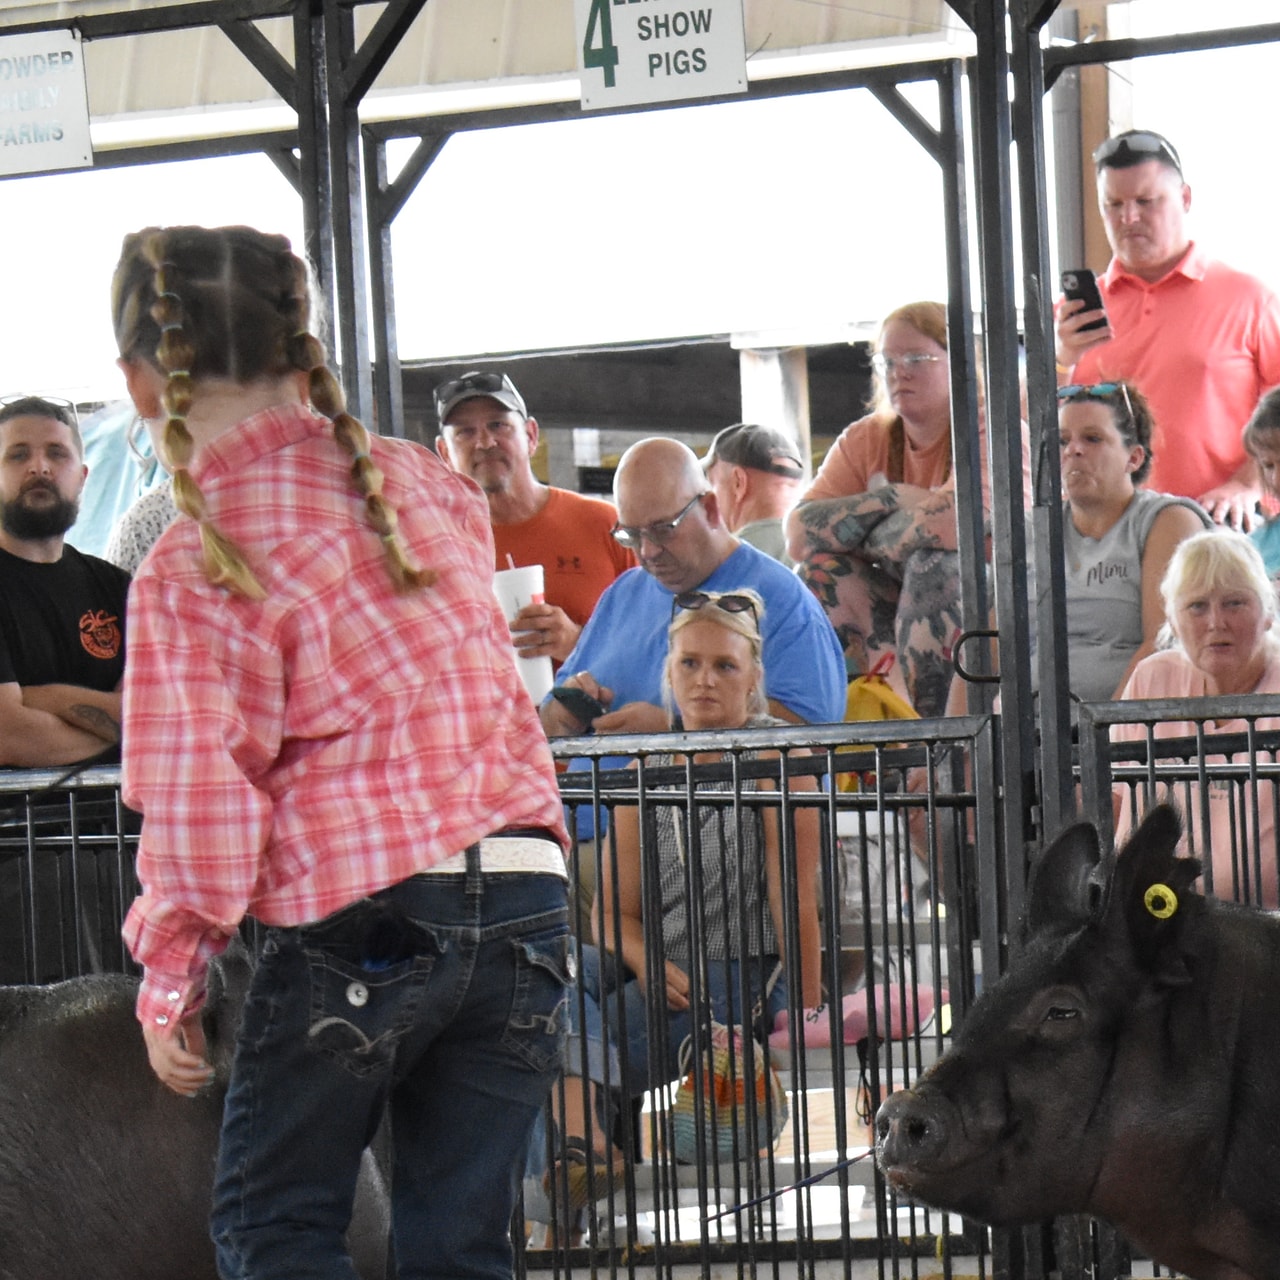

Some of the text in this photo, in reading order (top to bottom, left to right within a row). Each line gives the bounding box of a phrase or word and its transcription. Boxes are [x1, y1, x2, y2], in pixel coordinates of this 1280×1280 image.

[637, 8, 712, 41] SHOW
[583, 0, 619, 88] 4
[648, 47, 707, 77] PIGS
[0, 121, 64, 147] ARMS
[1086, 561, 1128, 587] Mimi
